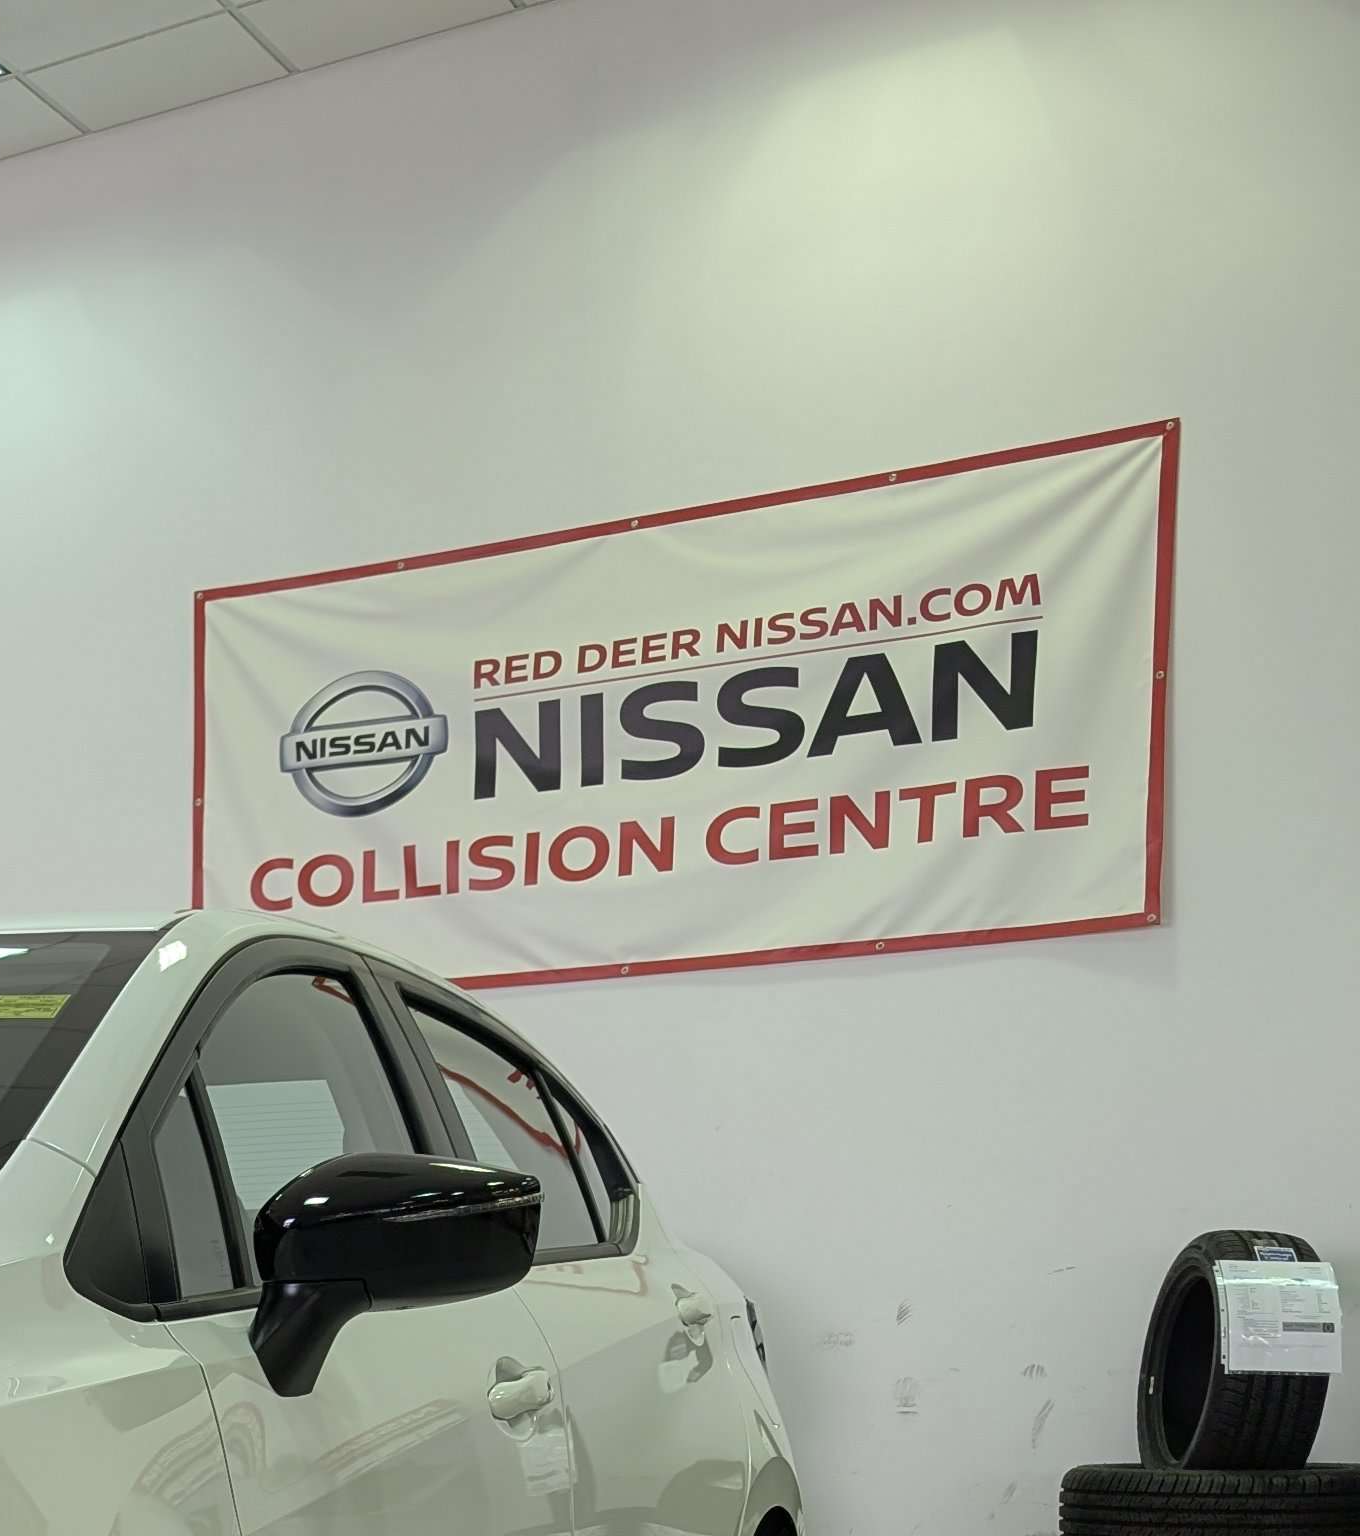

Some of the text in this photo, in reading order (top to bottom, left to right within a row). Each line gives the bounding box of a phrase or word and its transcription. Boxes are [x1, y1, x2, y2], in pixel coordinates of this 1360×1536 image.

[473, 572, 1043, 690] RED DEER NISSAN.COM
[294, 725, 431, 763] NISSAN
[473, 629, 1040, 802] NISSAN
[248, 764, 1091, 913] COLLISION CENTRE
